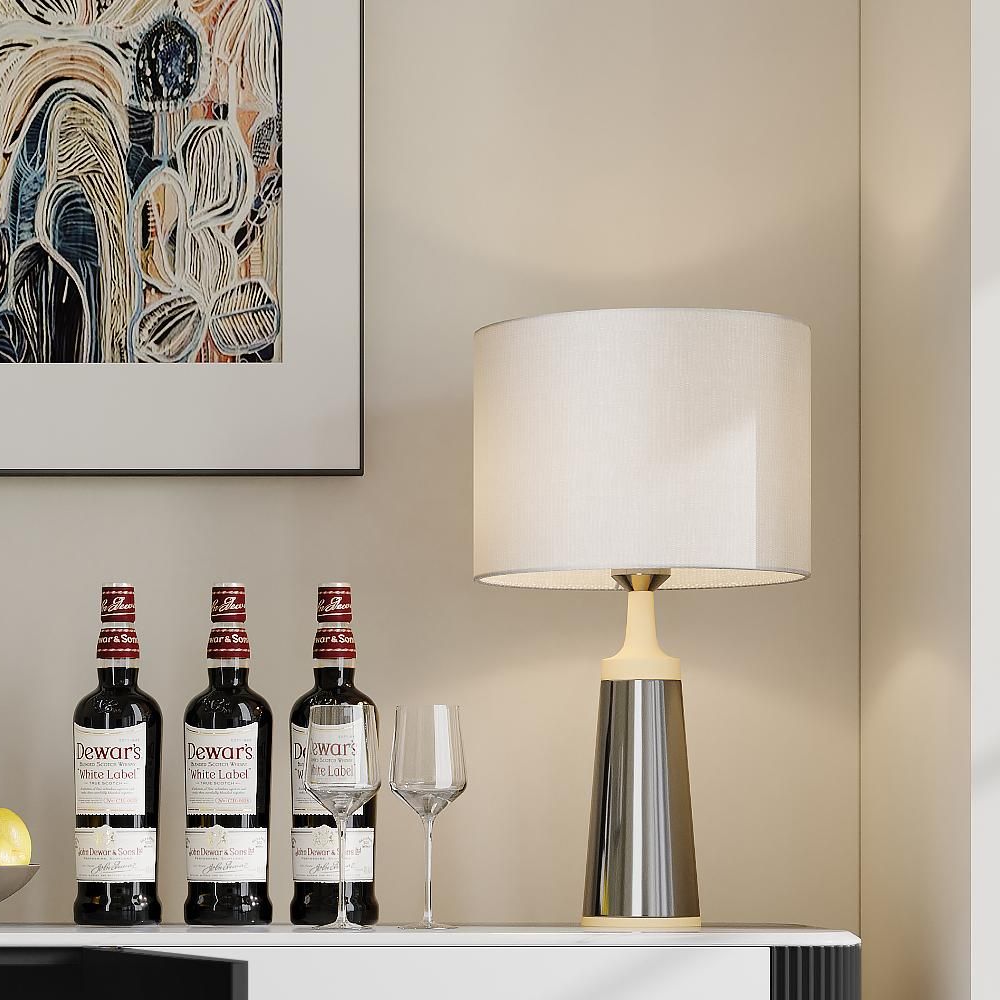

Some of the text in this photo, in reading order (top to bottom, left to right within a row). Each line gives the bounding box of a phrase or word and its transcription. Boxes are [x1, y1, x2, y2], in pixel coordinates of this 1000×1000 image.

[113, 635, 120, 643] &
[224, 635, 231, 643] &
[331, 635, 337, 643] &
[77, 742, 141, 760] Dewar's
[188, 742, 253, 760] Dewar's
[89, 848, 111, 856] Dewar
[200, 848, 223, 856] Dewar
[307, 848, 330, 856] Dewar
